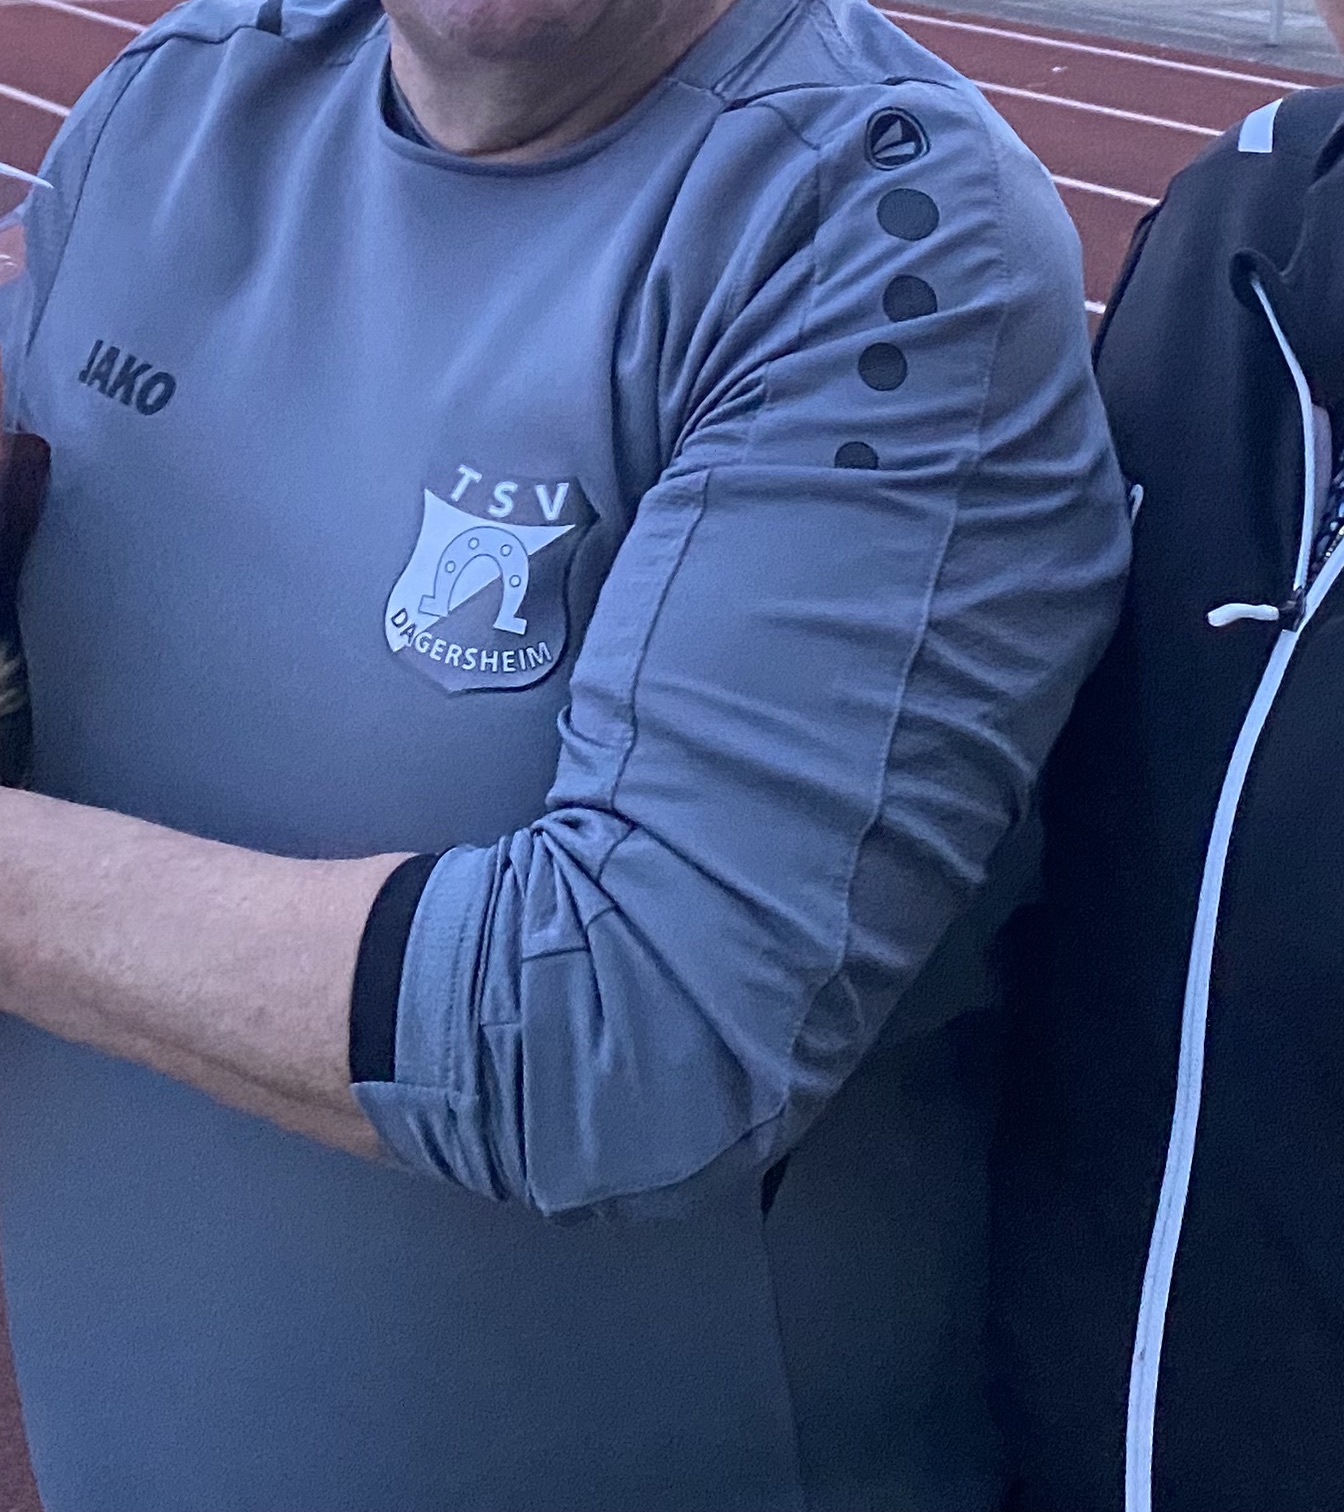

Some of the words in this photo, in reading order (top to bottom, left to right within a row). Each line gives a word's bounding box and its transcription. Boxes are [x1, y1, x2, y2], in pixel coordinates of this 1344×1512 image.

[78, 339, 177, 416] JAKO
[451, 464, 570, 521] TSV
[390, 607, 553, 674] DAGERSHEIM
